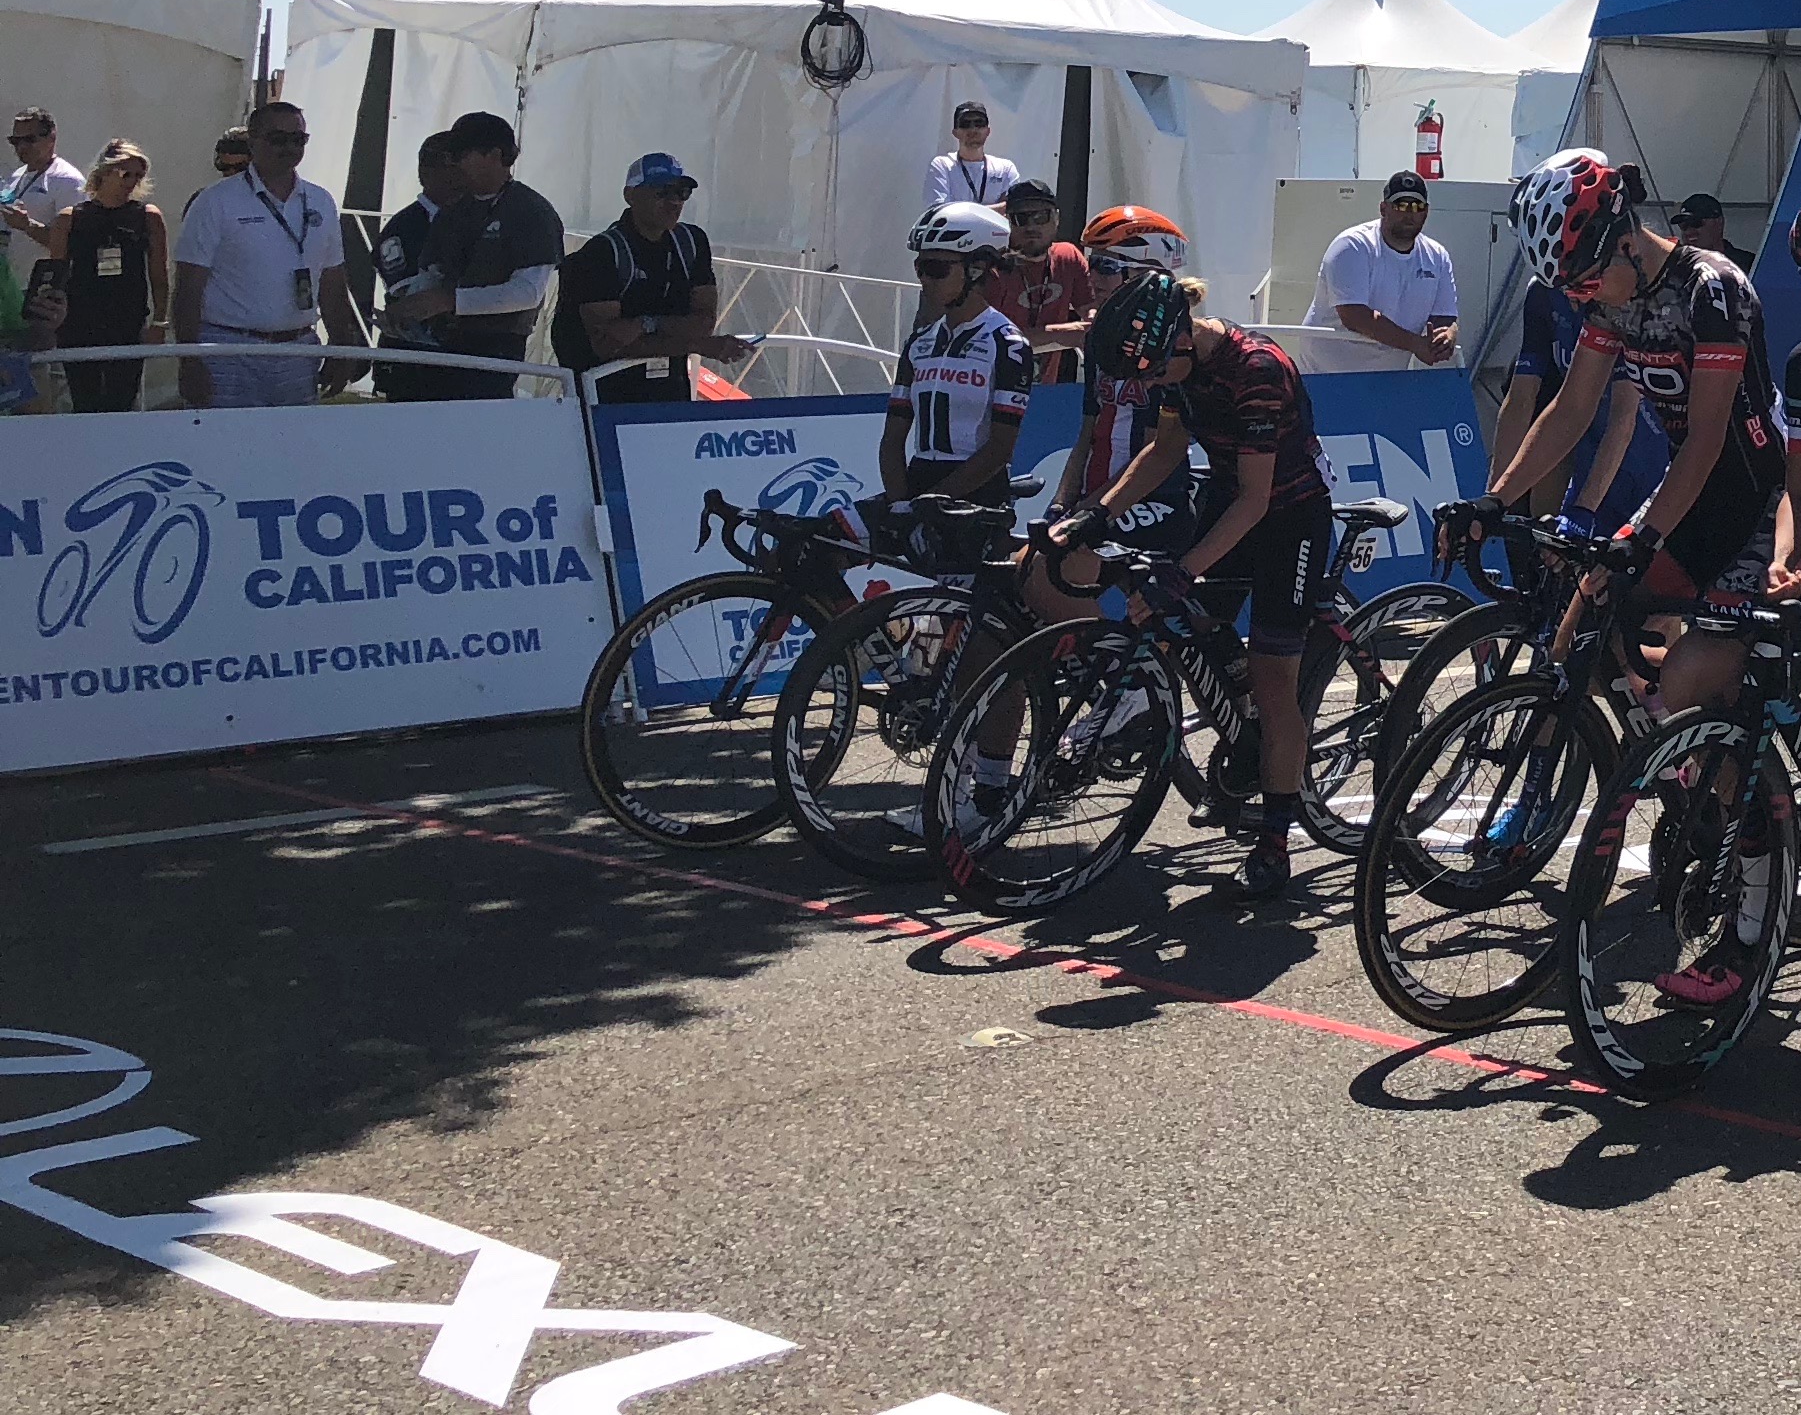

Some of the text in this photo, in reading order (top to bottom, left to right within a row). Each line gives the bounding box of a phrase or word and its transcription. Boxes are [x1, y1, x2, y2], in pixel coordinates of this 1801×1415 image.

[1624, 349, 1679, 364] ENTY
[1098, 379, 1150, 409] SA
[695, 428, 798, 460] AMGEN
[236, 488, 560, 561] TOUR of
[1114, 500, 1174, 534] USA
[245, 546, 593, 610] CALIFORNIA
[1294, 539, 1312, 606] SRAM
[1352, 545, 1373, 569] 56
[631, 592, 706, 650] GIANT
[1350, 594, 1449, 646] ZIPP
[1180, 646, 1242, 745] CANYON
[1442, 695, 1539, 750] ZIPP
[1640, 721, 1751, 790] ZIPP
[616, 792, 690, 836] GIANT
[1381, 933, 1451, 1011] ZIPP
